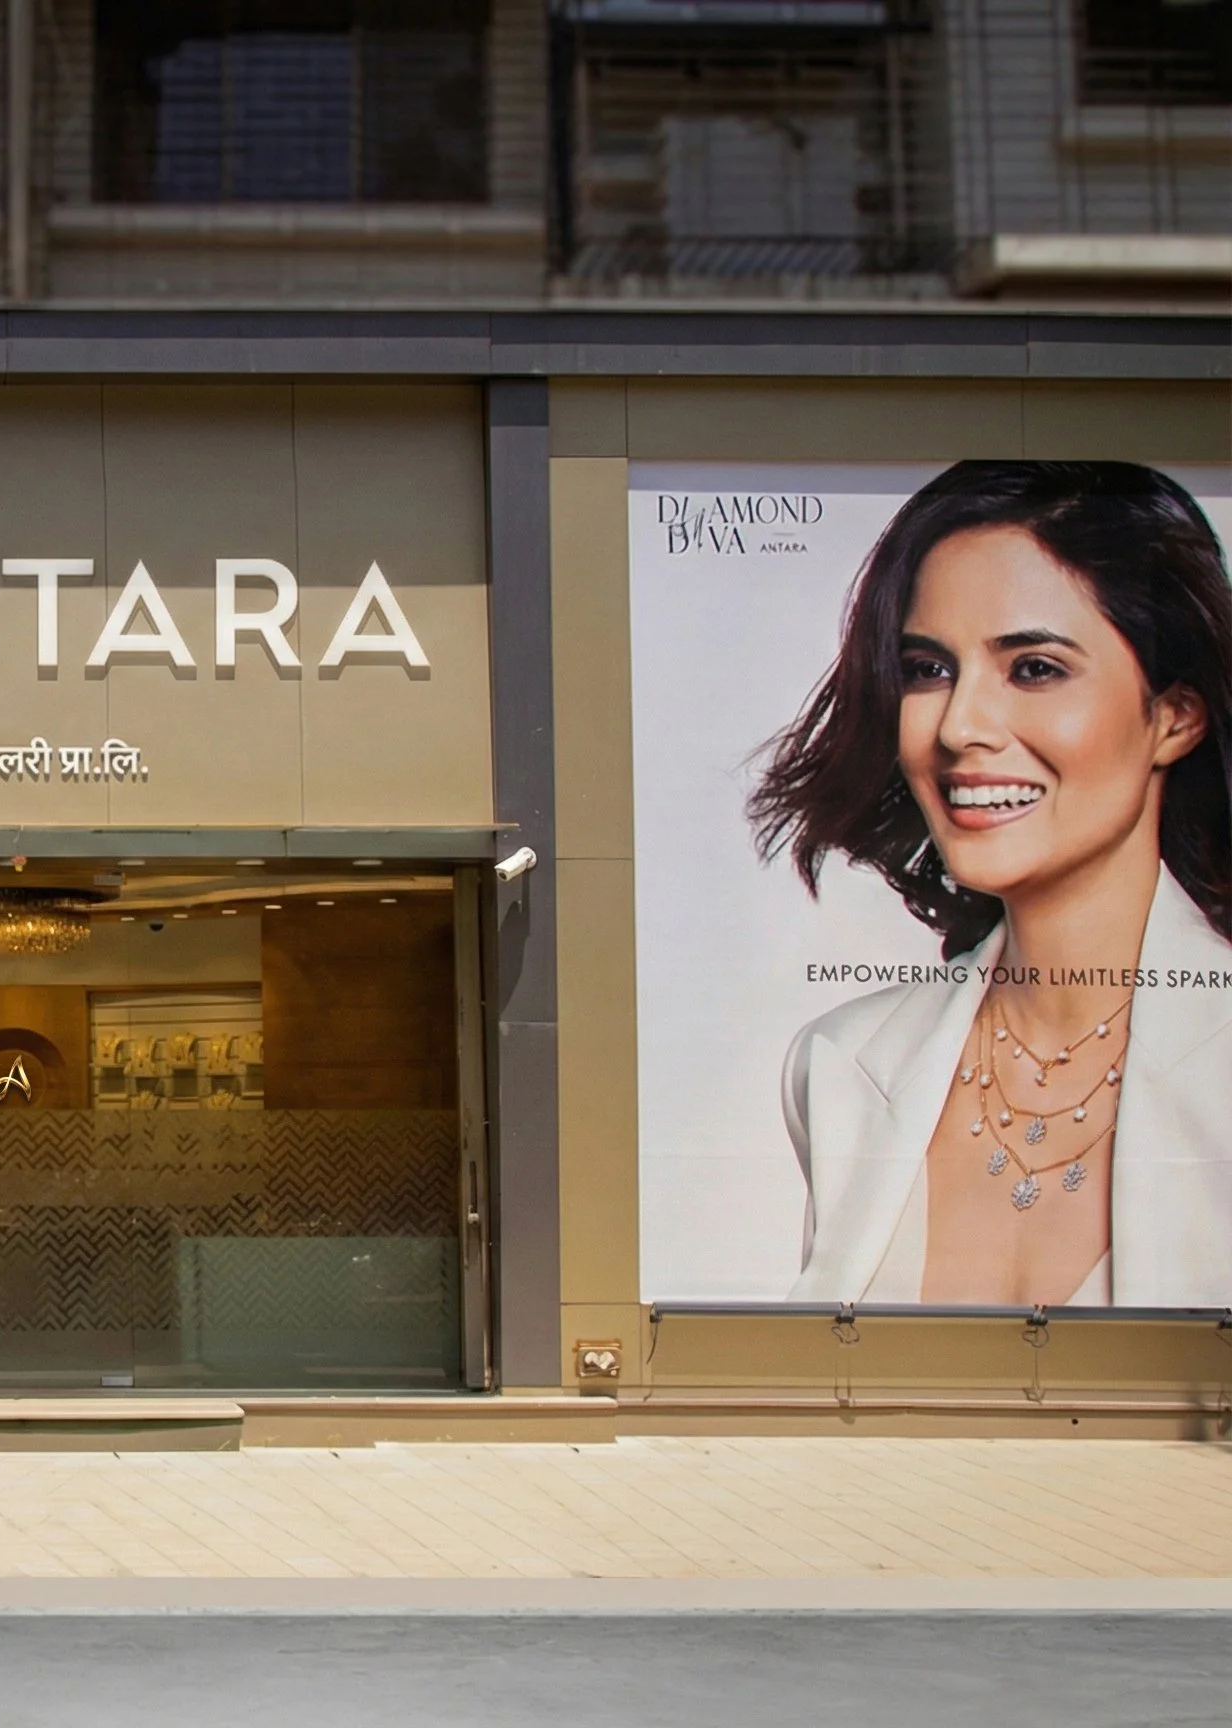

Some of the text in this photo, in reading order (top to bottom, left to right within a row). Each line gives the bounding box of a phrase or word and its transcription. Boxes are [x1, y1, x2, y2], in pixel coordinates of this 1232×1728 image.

[657, 494, 823, 525] DIAMOND
[759, 542, 808, 553] ANTARA
[806, 964, 1232, 989] EMPOWERING YOUR LIMITLESS SPARK
